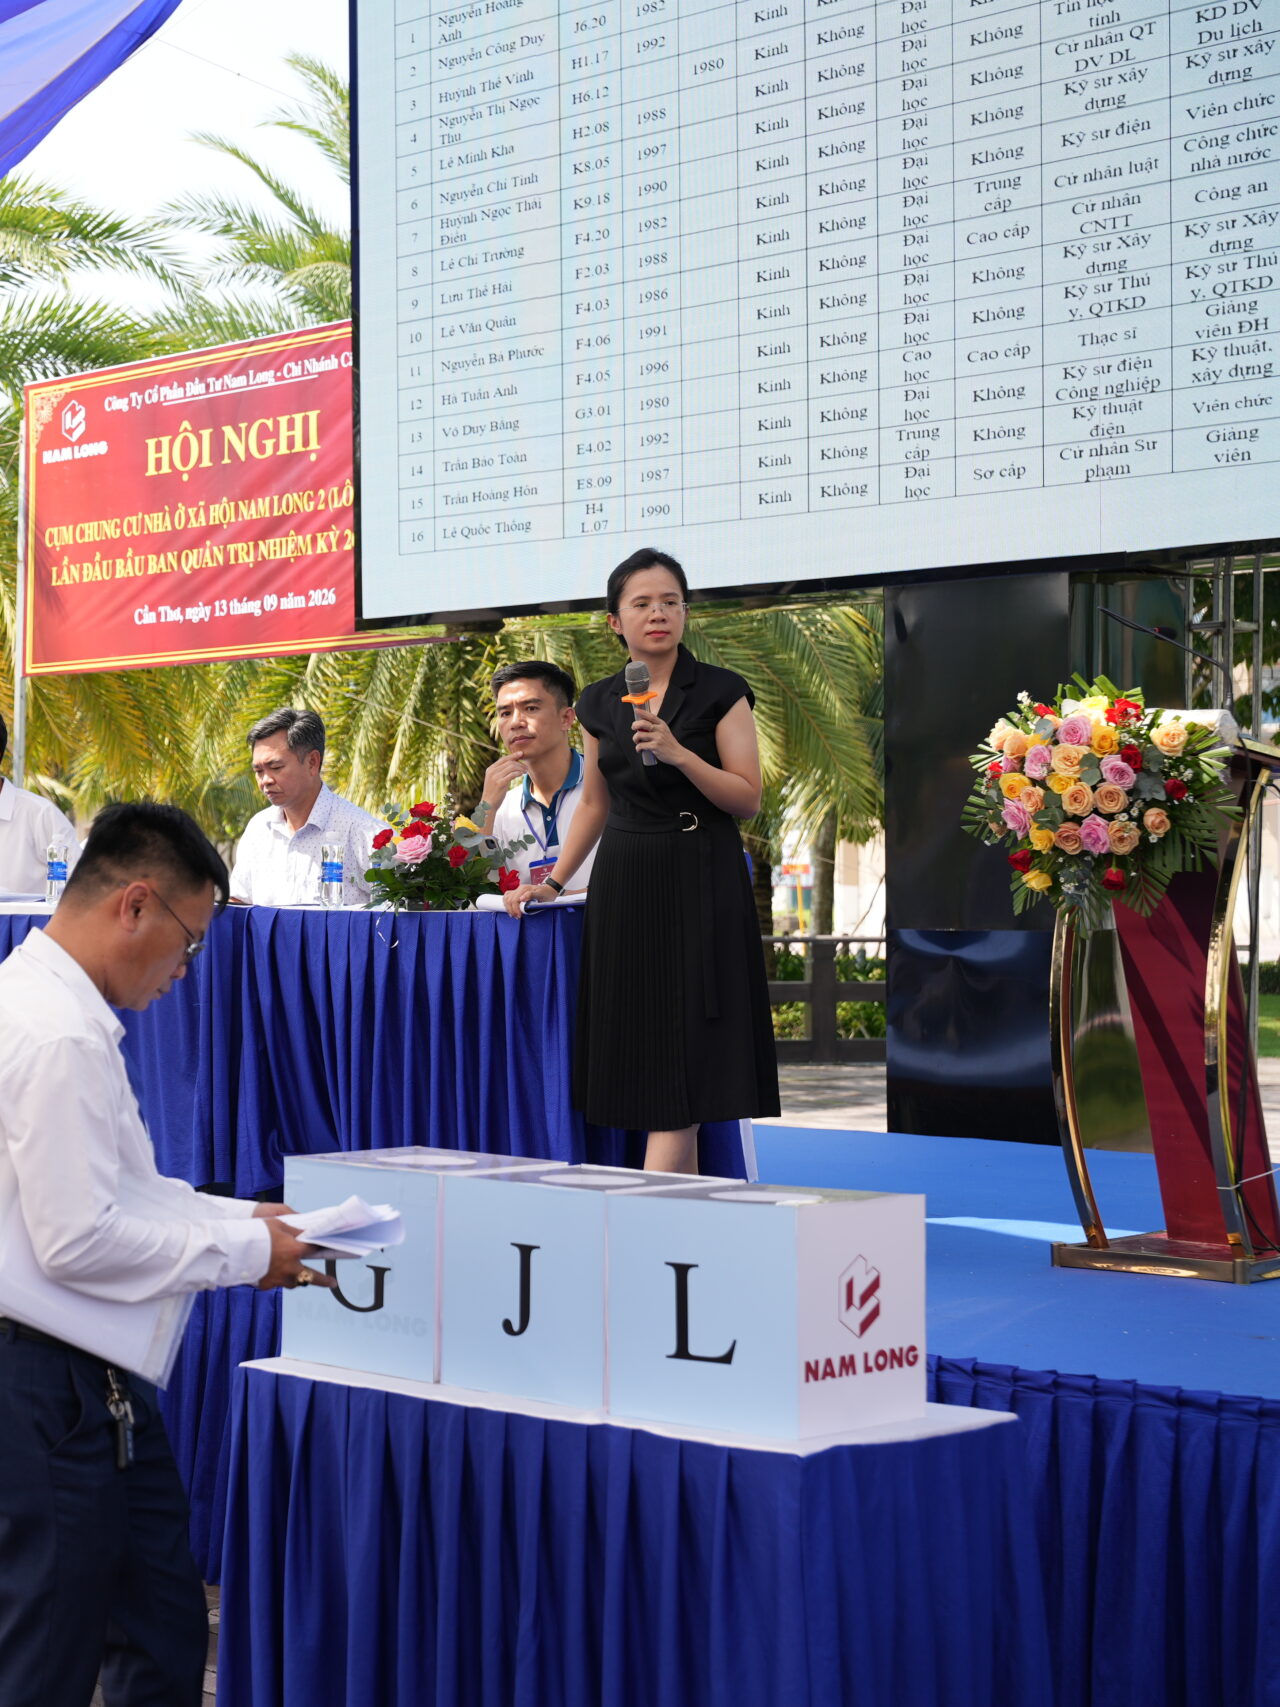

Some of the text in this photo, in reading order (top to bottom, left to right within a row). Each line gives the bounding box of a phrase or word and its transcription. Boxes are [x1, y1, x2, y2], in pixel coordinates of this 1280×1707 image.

[636, 0, 665, 17] 1982
[754, 5, 788, 24] Kinh
[1196, 6, 1226, 23] KD
[574, 16, 606, 33] J6.20
[1198, 19, 1262, 45] Du lịch
[521, 34, 545, 47] Duy
[817, 25, 864, 45] Không
[970, 25, 1023, 46] Không
[1084, 33, 1123, 49] nhân
[1130, 22, 1157, 39] QT
[637, 36, 666, 54] 1992
[755, 43, 789, 61] Kinh
[902, 36, 927, 52] Đại
[1218, 48, 1238, 61] sư
[1243, 40, 1276, 56] xây
[572, 51, 608, 69] H1.17
[694, 58, 724, 75] 1980
[902, 57, 927, 72] học
[1075, 49, 1135, 72] DV DL
[1208, 67, 1253, 86] dựng
[572, 87, 609, 104] H6.12
[1186, 93, 1275, 120] Viên chức
[637, 108, 666, 125] 1988
[573, 122, 609, 139] H2.08
[458, 150, 487, 166] Minh
[492, 145, 514, 157] Kha
[638, 144, 666, 161] 1997
[573, 158, 610, 175] K8.05
[638, 181, 667, 197] 1990
[974, 176, 1021, 193] Trung
[1195, 180, 1268, 203] Công an
[574, 193, 610, 209] K9.18
[639, 217, 668, 233] 1982
[1080, 214, 1133, 234] CNTT
[575, 229, 610, 245] F4.20
[967, 231, 998, 245] Cao
[639, 252, 668, 268] 1988
[575, 264, 609, 279] F2.03
[639, 289, 668, 304] 1986
[576, 299, 610, 315] F4.03
[640, 325, 667, 339] 1991
[1195, 317, 1269, 340] viên ĐH
[410, 333, 422, 343] 10
[576, 335, 610, 350] F4.06
[1078, 331, 1118, 347] Thạc
[411, 366, 421, 376] 11
[640, 361, 669, 376] 1996
[576, 370, 610, 385] F4.05
[130, 389, 143, 409] Ty
[224, 373, 246, 391] Nam
[248, 369, 275, 389] Long
[283, 363, 302, 379] Chi
[411, 400, 422, 409] 12
[640, 397, 669, 411] 1980
[575, 405, 611, 420] G3.01
[411, 433, 422, 443] 13
[641, 433, 669, 447] 1992
[896, 427, 940, 442] Trung
[42, 441, 108, 465] NAM LONG
[145, 410, 321, 481] HỘI NGHỊ
[577, 441, 611, 455] E4.02
[1215, 449, 1251, 463] viên
[411, 467, 423, 476] 14
[641, 469, 669, 483] 1987
[905, 466, 930, 479] Đại
[577, 476, 612, 490] E8.09
[821, 482, 868, 498] Không
[759, 491, 792, 505] Kinh
[905, 485, 930, 499] học
[411, 500, 423, 509] 15
[586, 503, 603, 514] H4
[641, 504, 670, 518] 1990
[45, 525, 74, 551] CỤM
[76, 518, 120, 543] CHUNG
[123, 512, 143, 536] CƯ
[144, 505, 171, 534] NHÀ
[187, 502, 206, 526] XÃ
[209, 497, 235, 525] HỘI
[238, 498, 270, 521] NAM
[273, 491, 314, 516] LONG
[318, 489, 326, 510] 2
[329, 479, 354, 512] (LÔ
[581, 520, 608, 533] L.07
[411, 532, 424, 542] 16
[52, 556, 79, 586] LẦN
[82, 552, 113, 583] ĐẦU
[116, 547, 144, 578] BẦU
[147, 552, 178, 575] BAN
[181, 541, 224, 575] QUẢN
[227, 542, 254, 569] TRỊ
[258, 531, 313, 563] NHIỆM
[316, 525, 340, 554] KỲ
[185, 601, 210, 622] ngày
[215, 601, 227, 617] 13
[230, 597, 261, 617] tháng
[264, 594, 277, 612] 09
[280, 591, 305, 609] năm
[308, 588, 336, 606] 2026
[325, 1248, 391, 1313] G
[502, 1242, 540, 1336] J
[664, 1261, 737, 1365] L
[805, 1345, 918, 1383] NAM LONG
